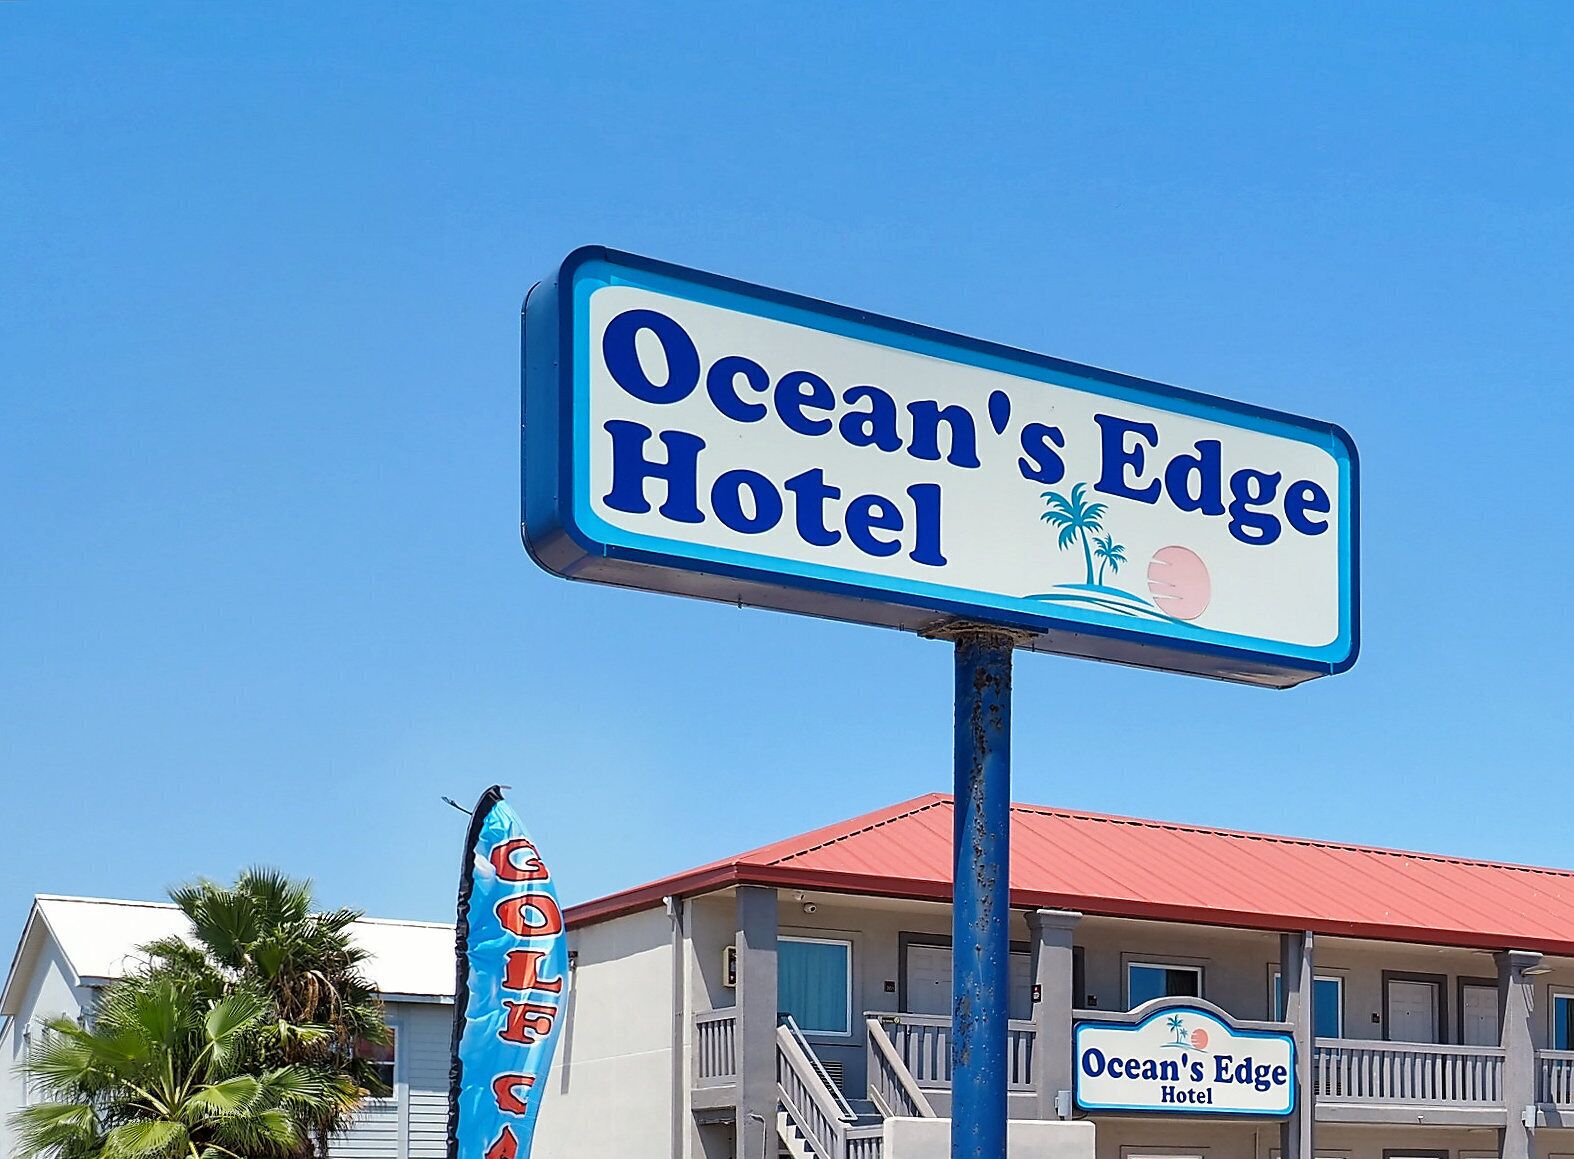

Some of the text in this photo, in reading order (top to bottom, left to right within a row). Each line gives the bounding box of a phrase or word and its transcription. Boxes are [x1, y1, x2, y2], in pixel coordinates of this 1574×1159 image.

[602, 309, 1331, 546] Ocean's Edge
[602, 419, 948, 568] Hotel
[489, 839, 563, 1044] GOLF
[1082, 1048, 1288, 1092] Ocean's Edge
[1161, 1085, 1213, 1104] Hotel
